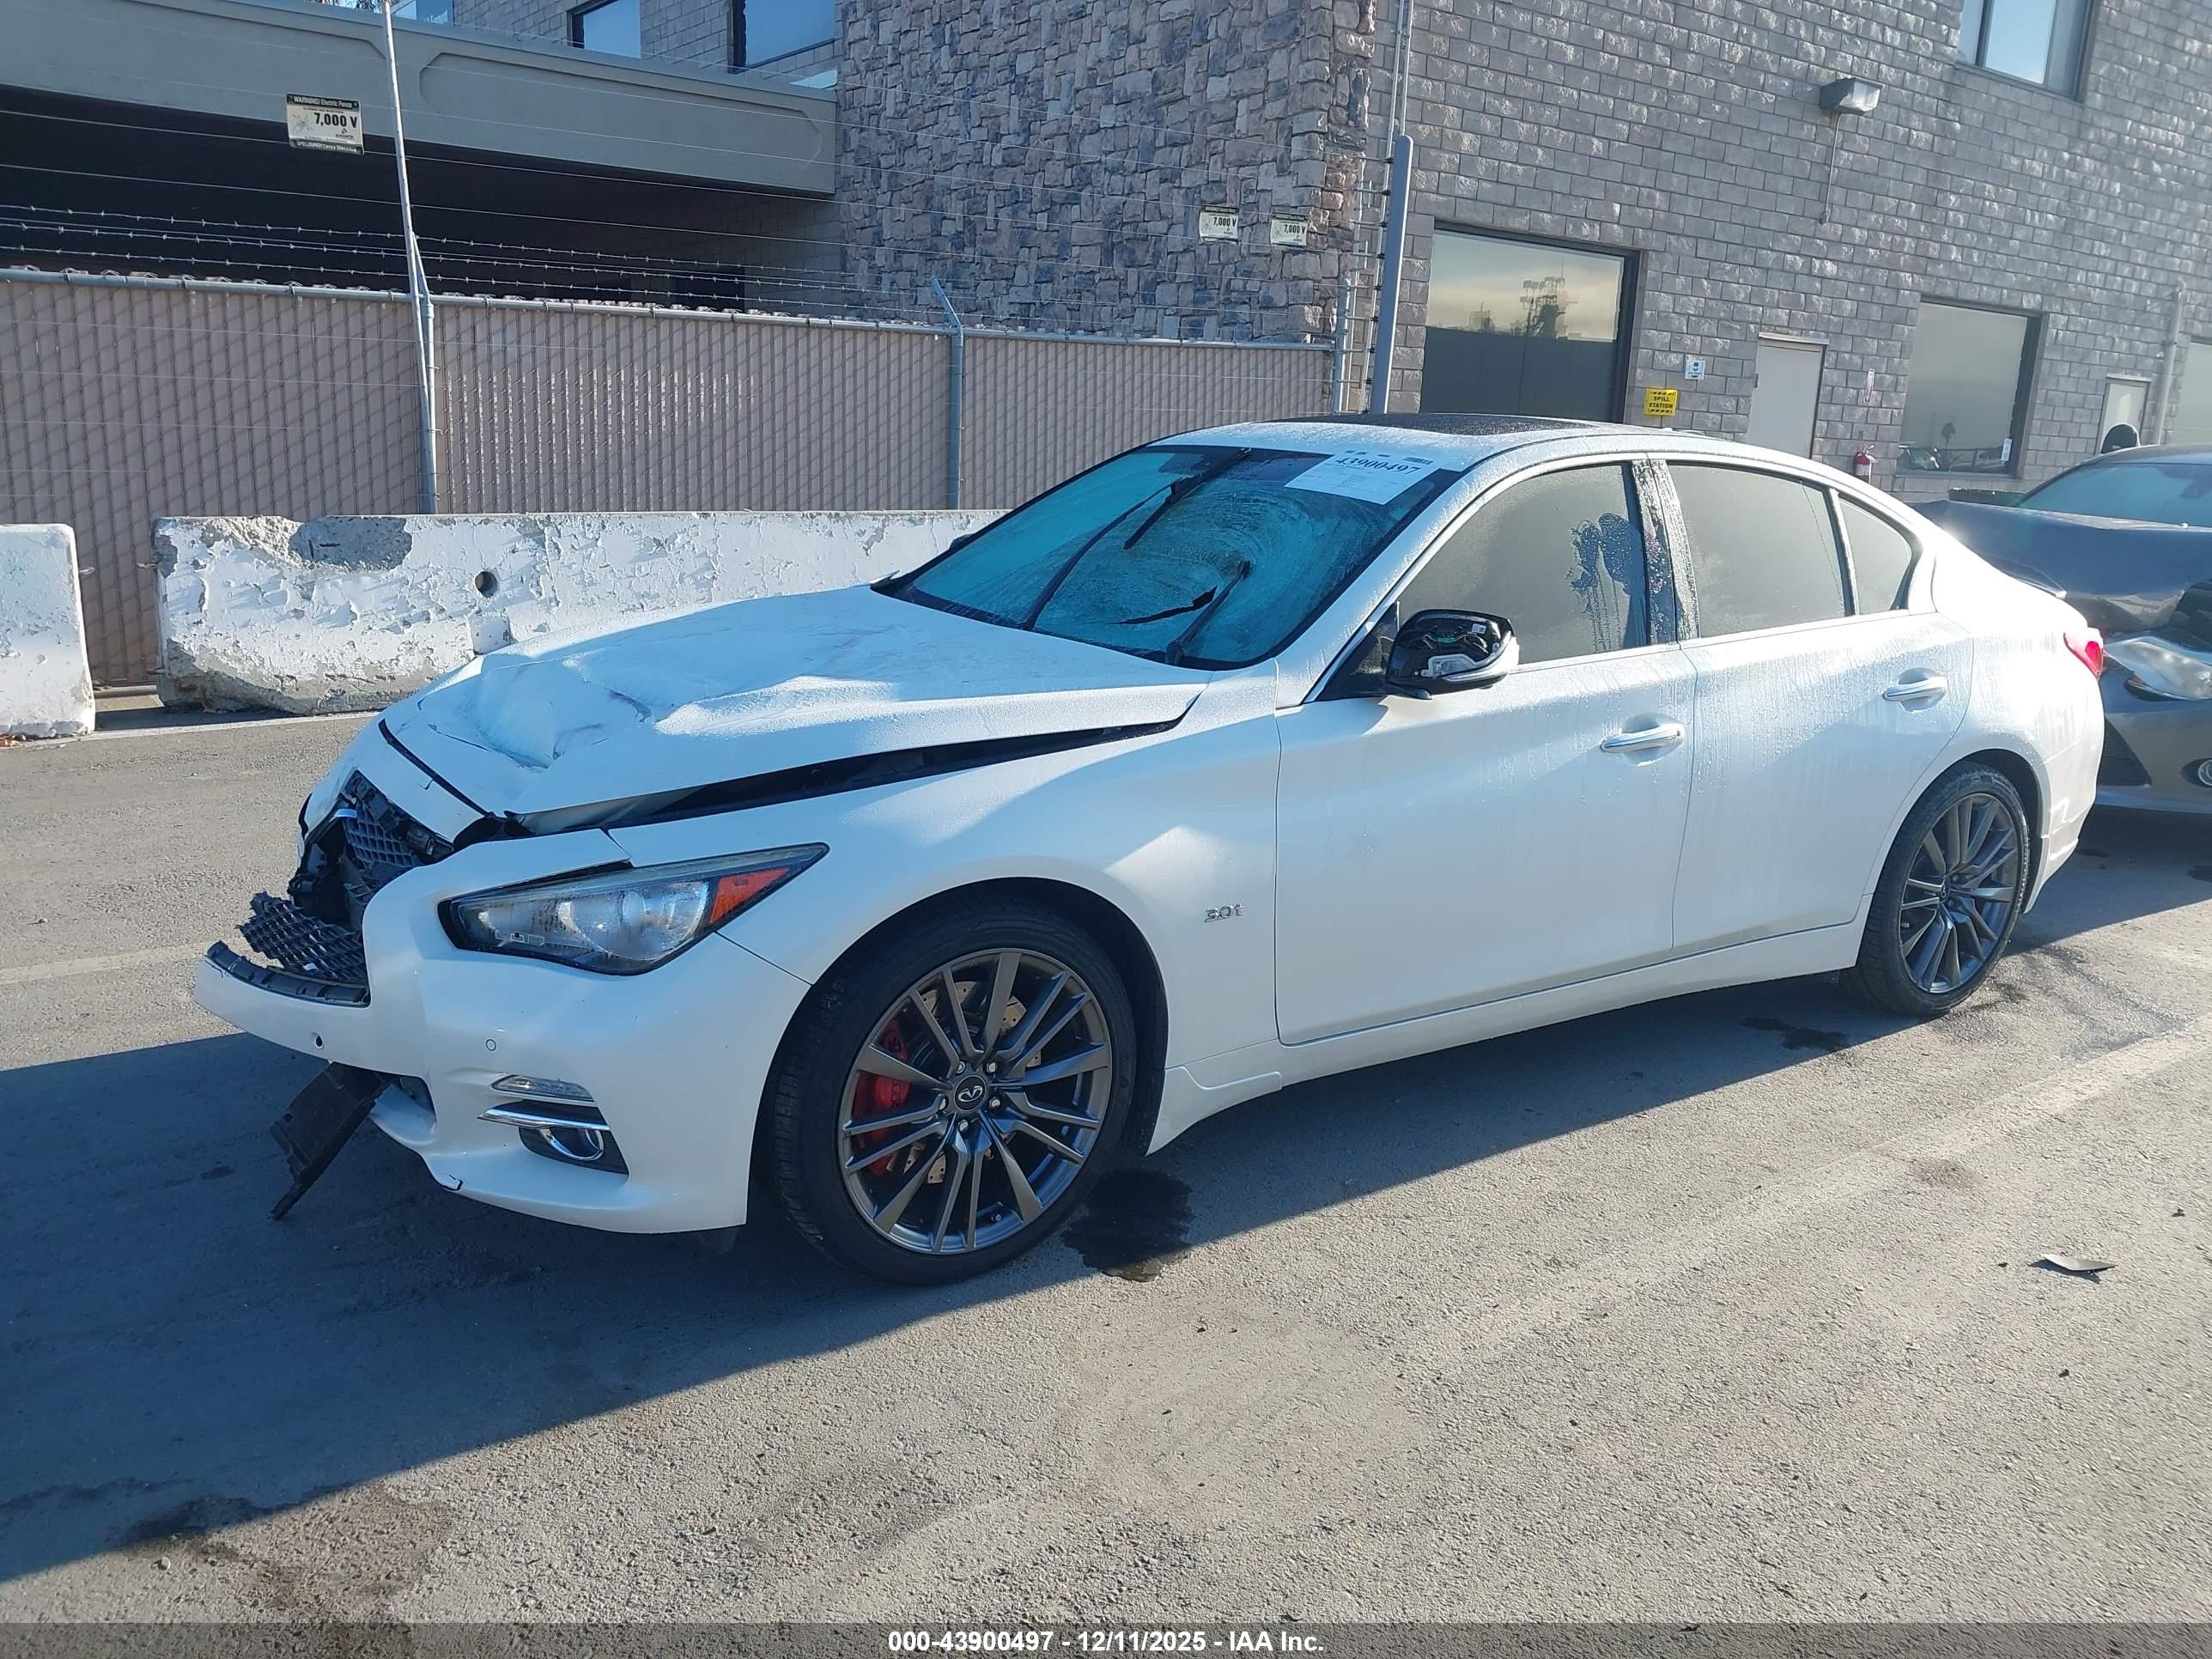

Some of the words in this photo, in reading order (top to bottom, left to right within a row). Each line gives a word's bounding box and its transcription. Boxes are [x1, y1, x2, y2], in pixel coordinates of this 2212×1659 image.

[314, 112, 347, 126] 7,000
[350, 116, 358, 128] V
[1213, 216, 1231, 228] 7,000
[1232, 218, 1237, 228] V
[1284, 224, 1301, 234] 7,000
[1302, 225, 1306, 234] V
[1334, 457, 1422, 474] 43900497
